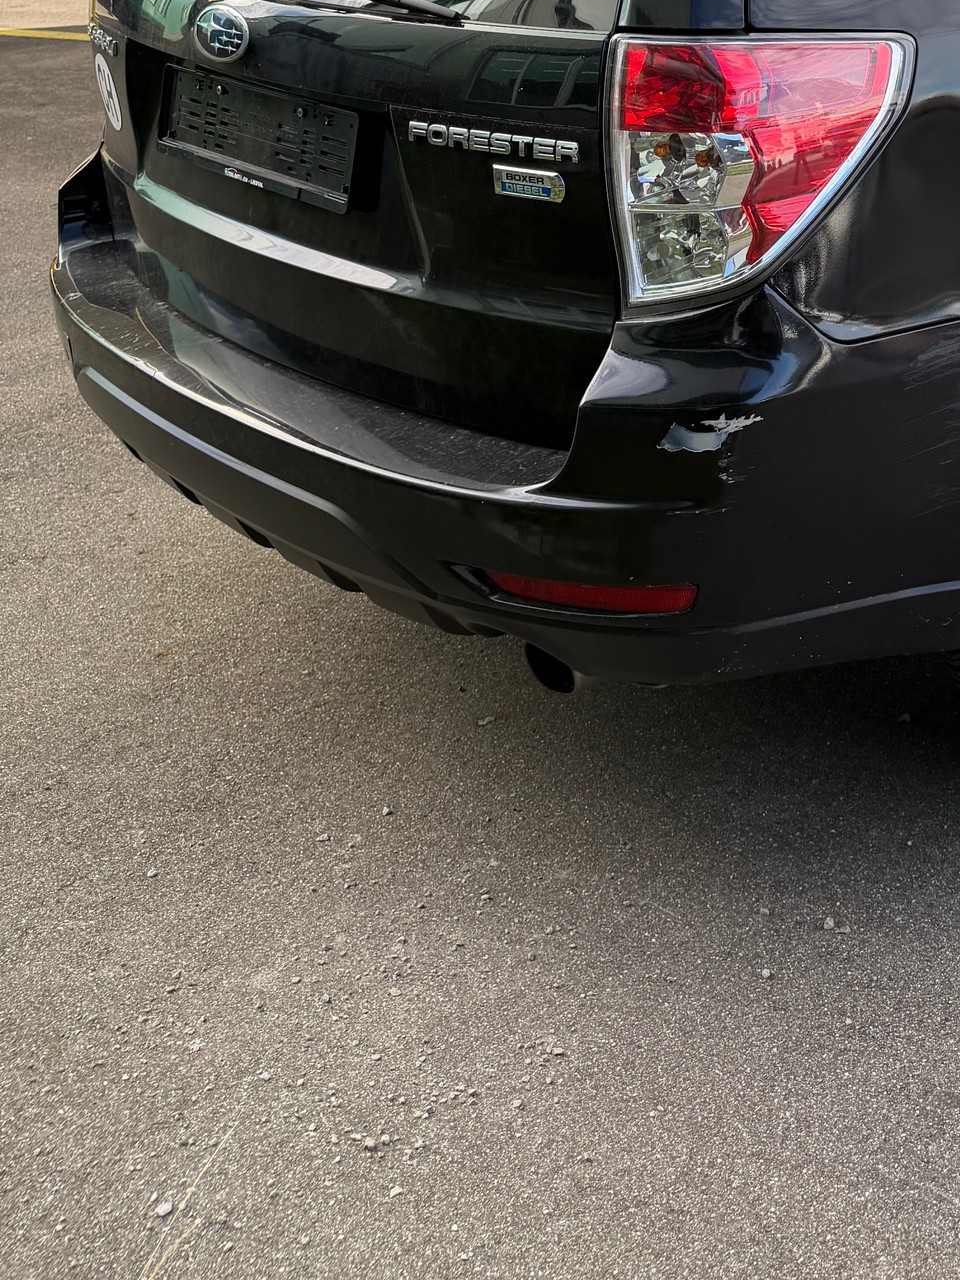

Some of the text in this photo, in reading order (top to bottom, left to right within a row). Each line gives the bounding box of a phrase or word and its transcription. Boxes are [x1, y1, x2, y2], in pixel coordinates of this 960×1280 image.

[96, 62, 120, 124] CH
[408, 120, 580, 164] FORESTER
[505, 172, 545, 185] BOXER
[505, 183, 548, 197] DIESEL
